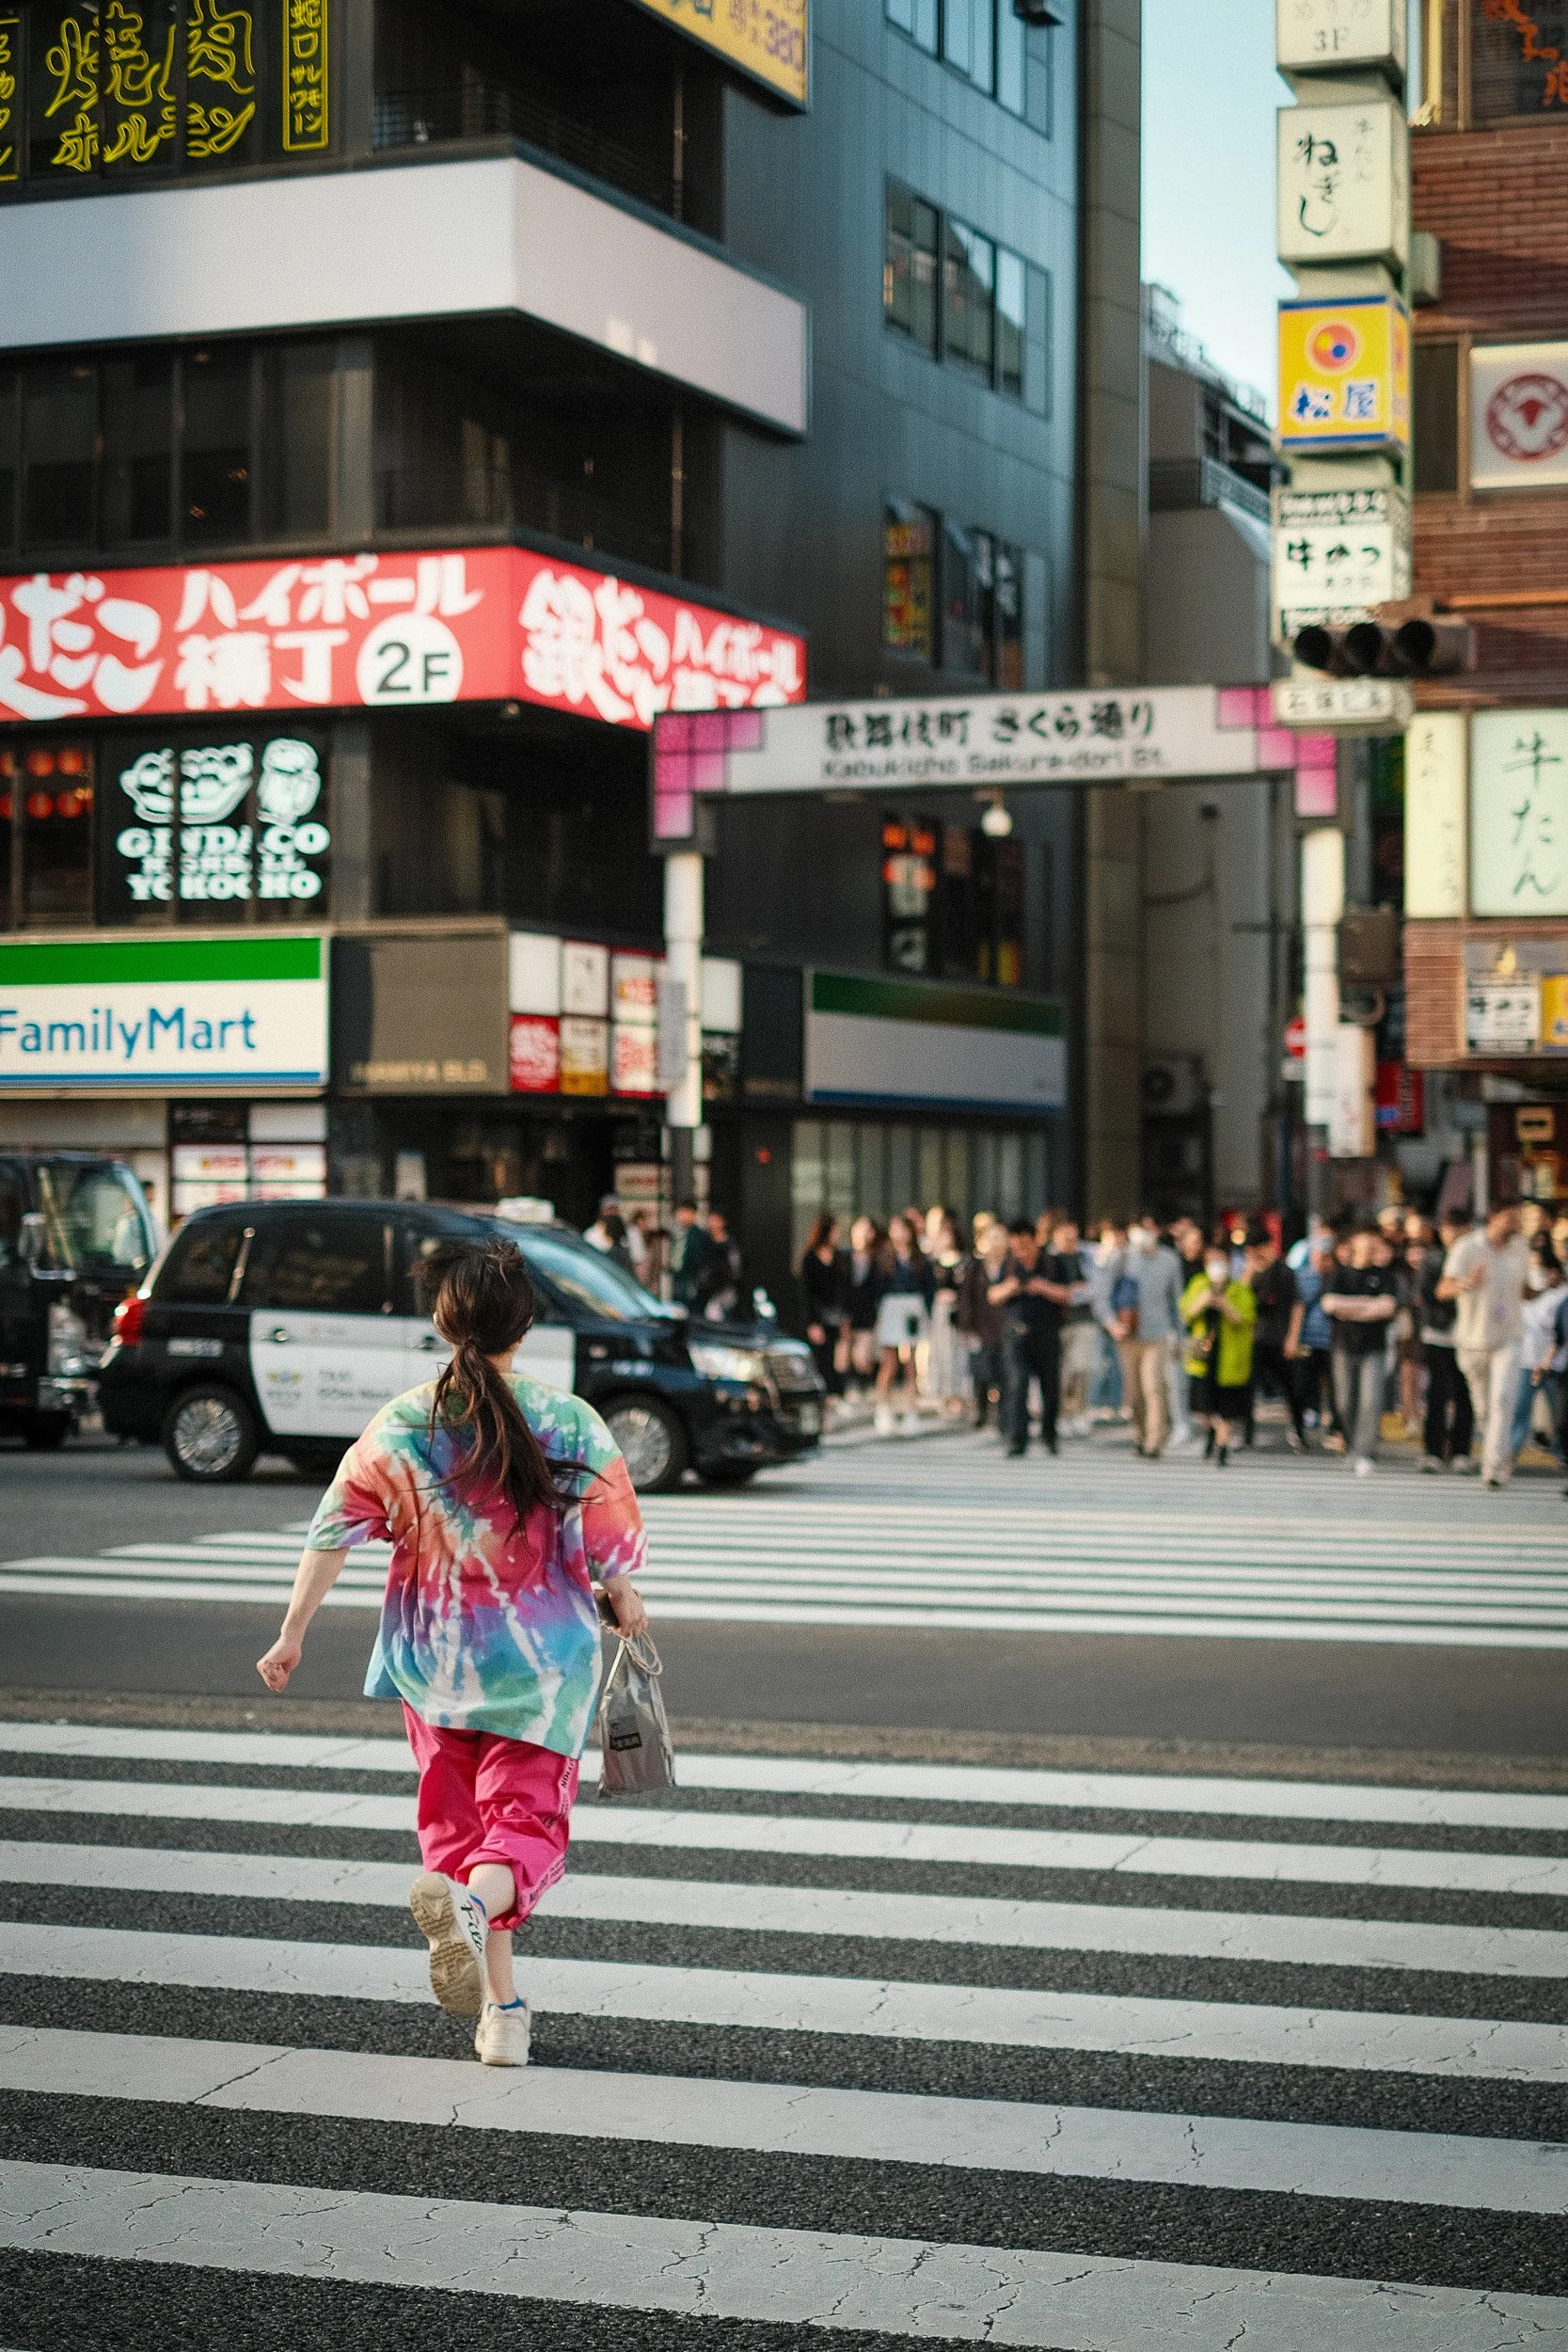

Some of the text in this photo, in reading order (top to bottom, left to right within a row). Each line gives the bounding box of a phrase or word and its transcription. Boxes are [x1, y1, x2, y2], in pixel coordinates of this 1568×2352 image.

[1294, 132, 1342, 237] ねぎし
[1292, 381, 1376, 420] 松屋
[1286, 537, 1382, 572] 牛かつ
[175, 553, 485, 633] ハイボール
[0, 572, 165, 723] だこ
[175, 628, 350, 709] 横丁
[376, 640, 451, 693] 2F
[991, 700, 1154, 743] さくら通り
[1501, 730, 1563, 898] 牛たん
[0, 1006, 257, 1060] FamilyMart
